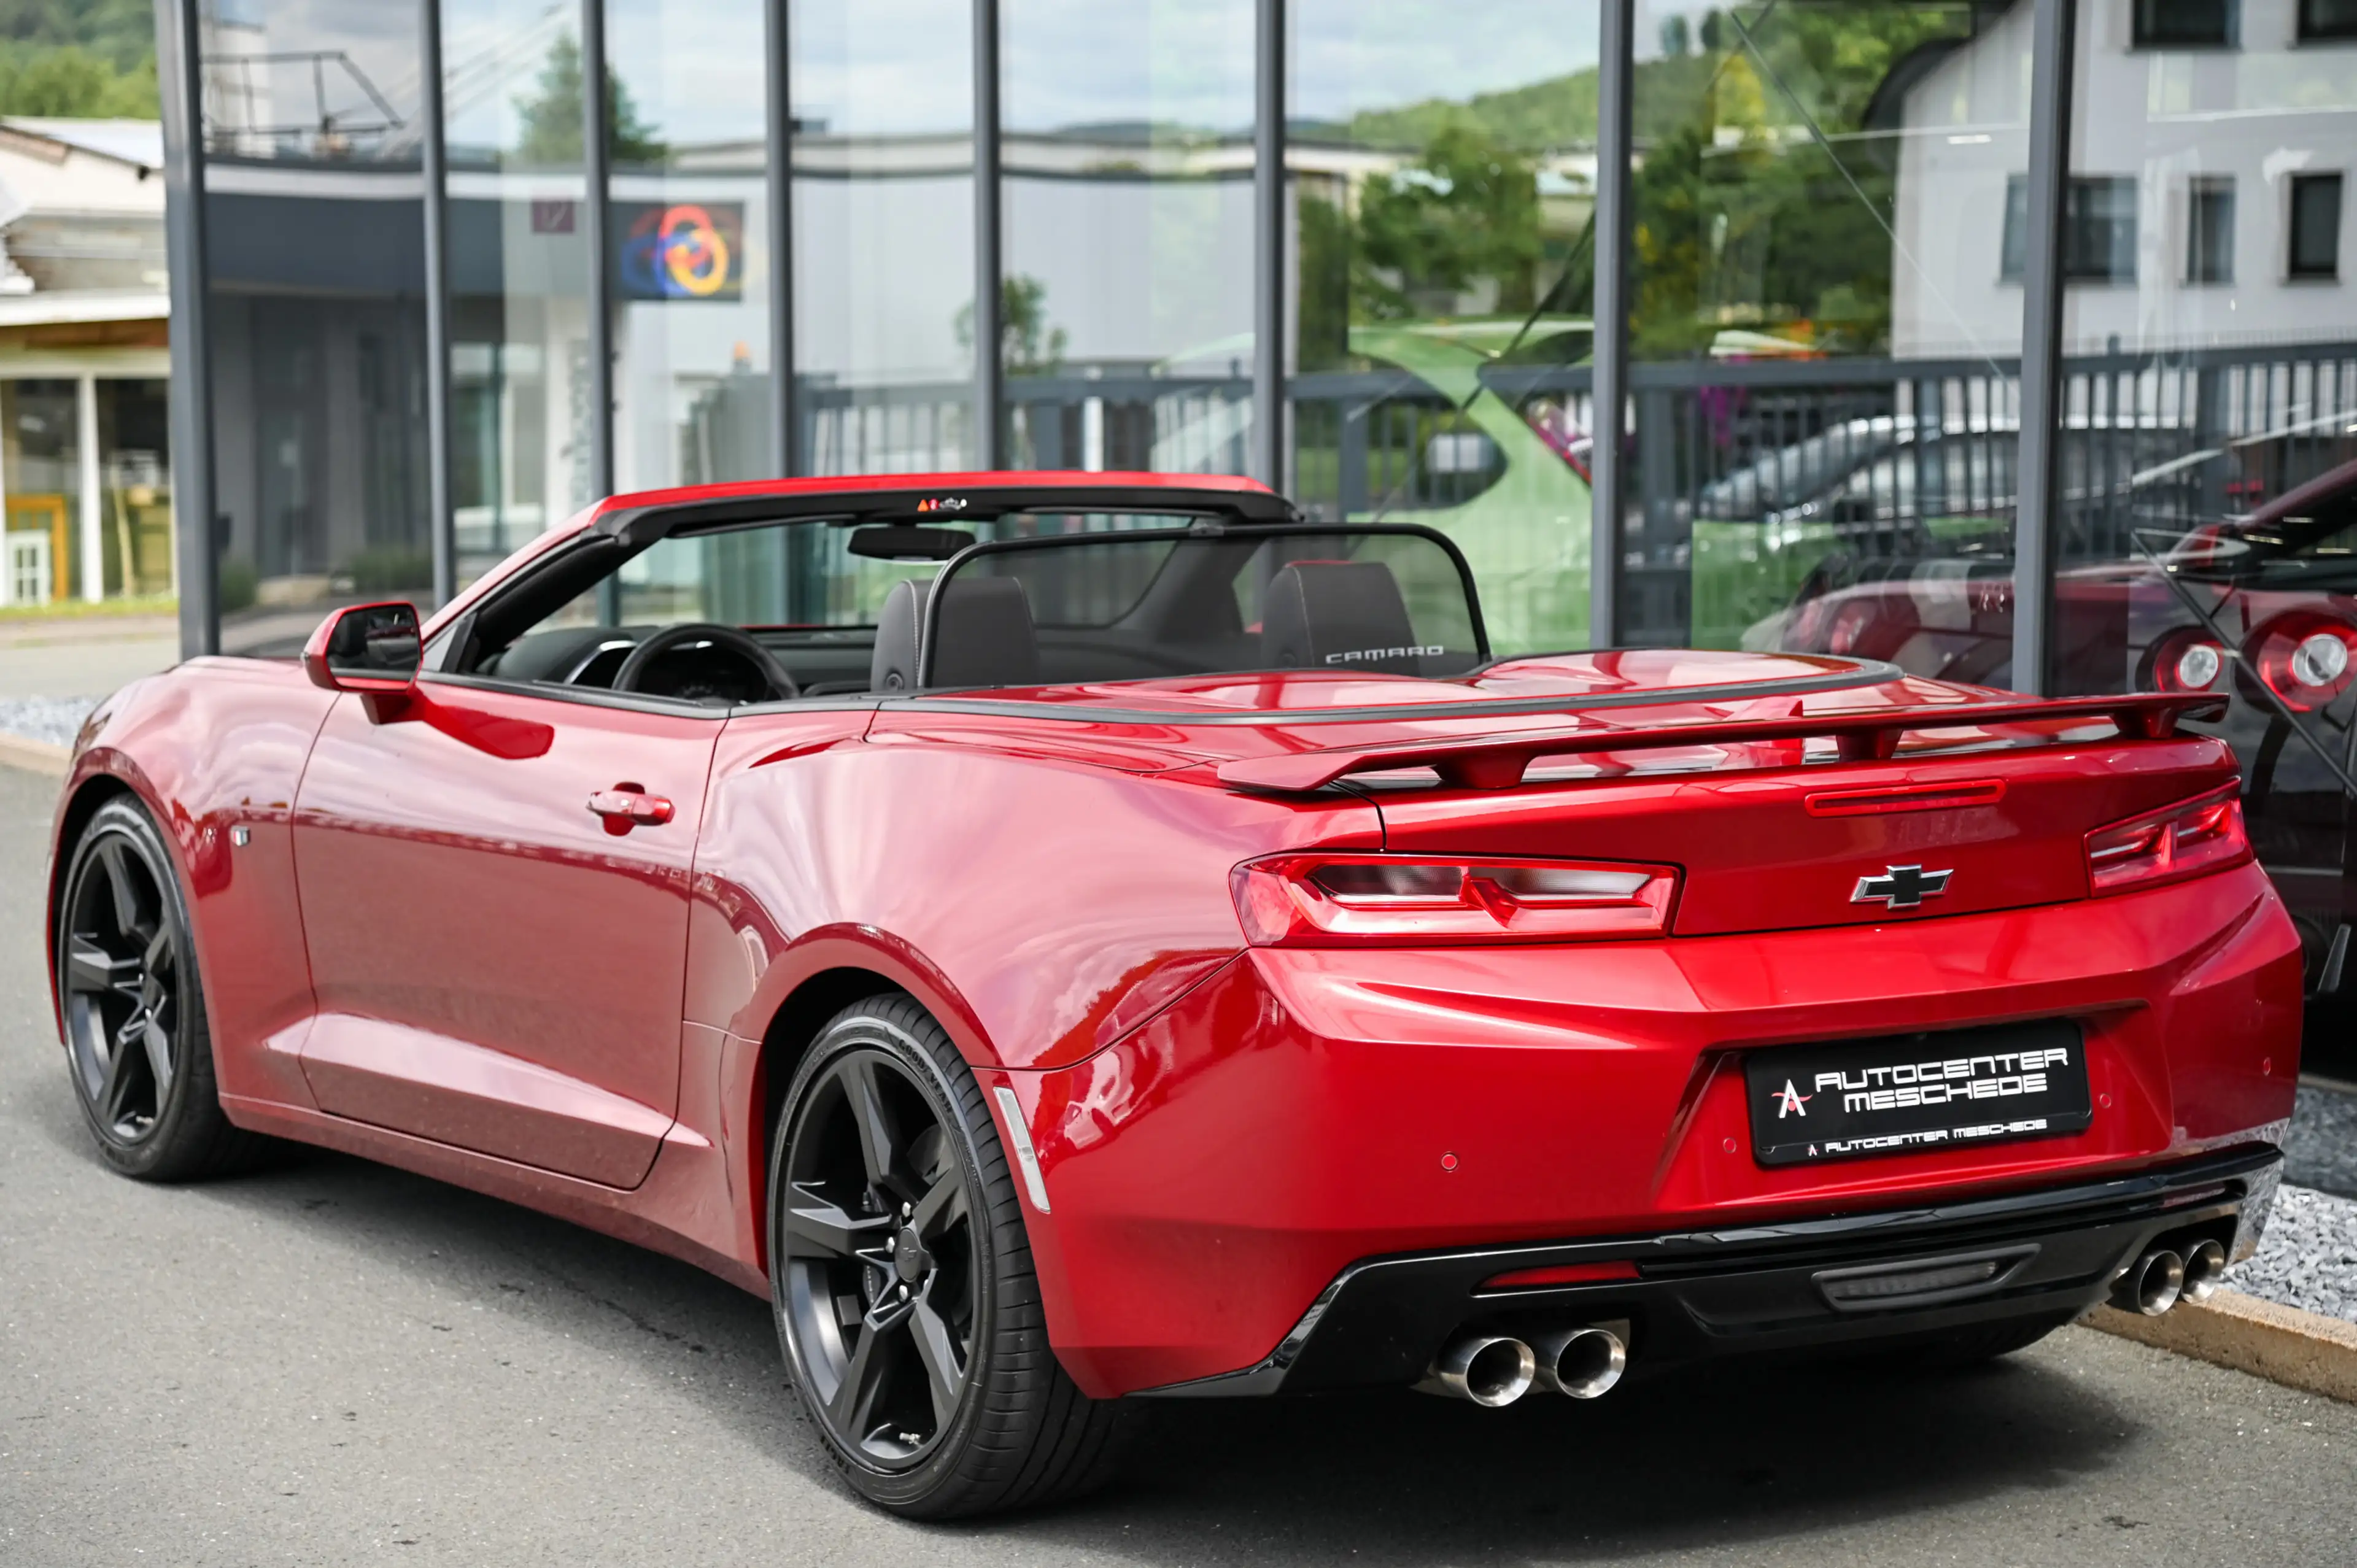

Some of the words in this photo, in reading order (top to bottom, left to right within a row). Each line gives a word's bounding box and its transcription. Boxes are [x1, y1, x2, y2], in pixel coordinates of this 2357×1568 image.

[1326, 645, 1444, 664] CAMARO
[1814, 1048, 2068, 1092] AUTOCENTER
[1844, 1073, 2048, 1113] MESCHEDE
[1825, 1130, 1948, 1153] AUTOCENTER
[1953, 1119, 2048, 1138] MESCHEDE
